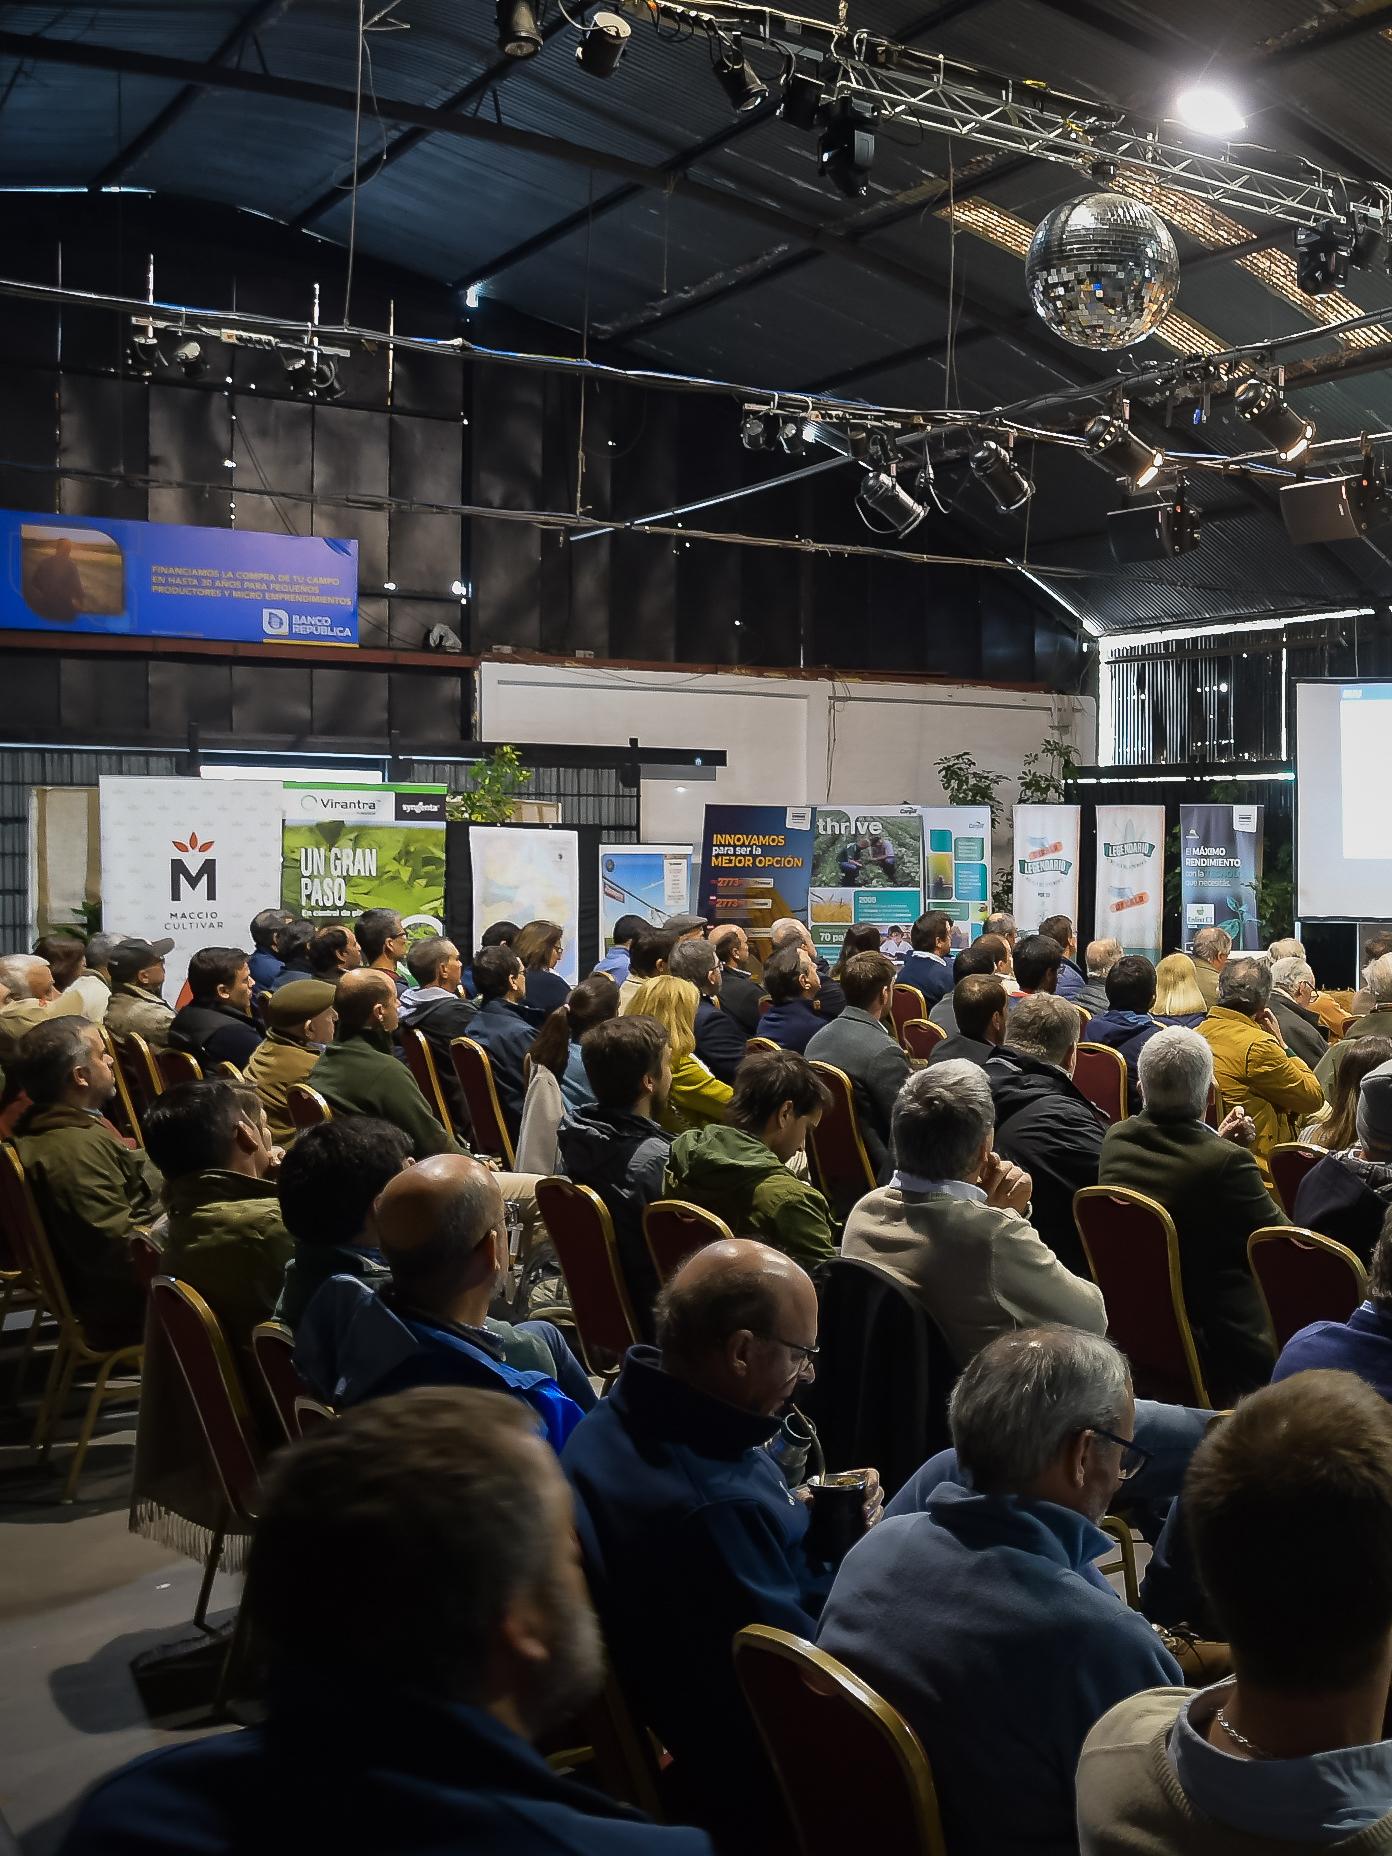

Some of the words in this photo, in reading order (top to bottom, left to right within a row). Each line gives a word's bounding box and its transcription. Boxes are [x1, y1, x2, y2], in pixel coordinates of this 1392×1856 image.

[152, 566, 220, 578] FINANCIAMOS
[222, 570, 234, 579] LA
[236, 571, 276, 582] COMPRA
[307, 576, 340, 586] CAMPO
[152, 576, 166, 584] EN
[168, 576, 198, 586] HASTA
[244, 582, 268, 590] PARA
[152, 585, 222, 598] PRODUCTORES
[232, 590, 263, 600] MICRO
[265, 592, 353, 606] EMPRENDIMIENTOS
[292, 614, 332, 626] BANCO
[320, 798, 376, 810] Virantra
[816, 818, 883, 835] thrive
[712, 834, 785, 846] INNOVAMOS
[712, 847, 734, 856] para
[735, 847, 751, 855] ser
[752, 845, 762, 855] la
[1108, 843, 1149, 856] LEGENDARIO
[1192, 846, 1226, 856] MÁXIMO
[300, 847, 325, 876] UN
[330, 847, 377, 877] GRAN
[711, 856, 753, 867] MEJOR
[755, 854, 803, 868] OPCIÓN
[1024, 860, 1067, 874] LEGENDARIO
[1185, 858, 1241, 867] RENDIMIENTO
[1197, 869, 1205, 877] la
[170, 858, 217, 902] M
[1185, 880, 1198, 888] que
[300, 877, 346, 907] PASO
[169, 911, 219, 920] MACCIO
[164, 921, 224, 931] CULTIVAR
[819, 932, 831, 942] 70
